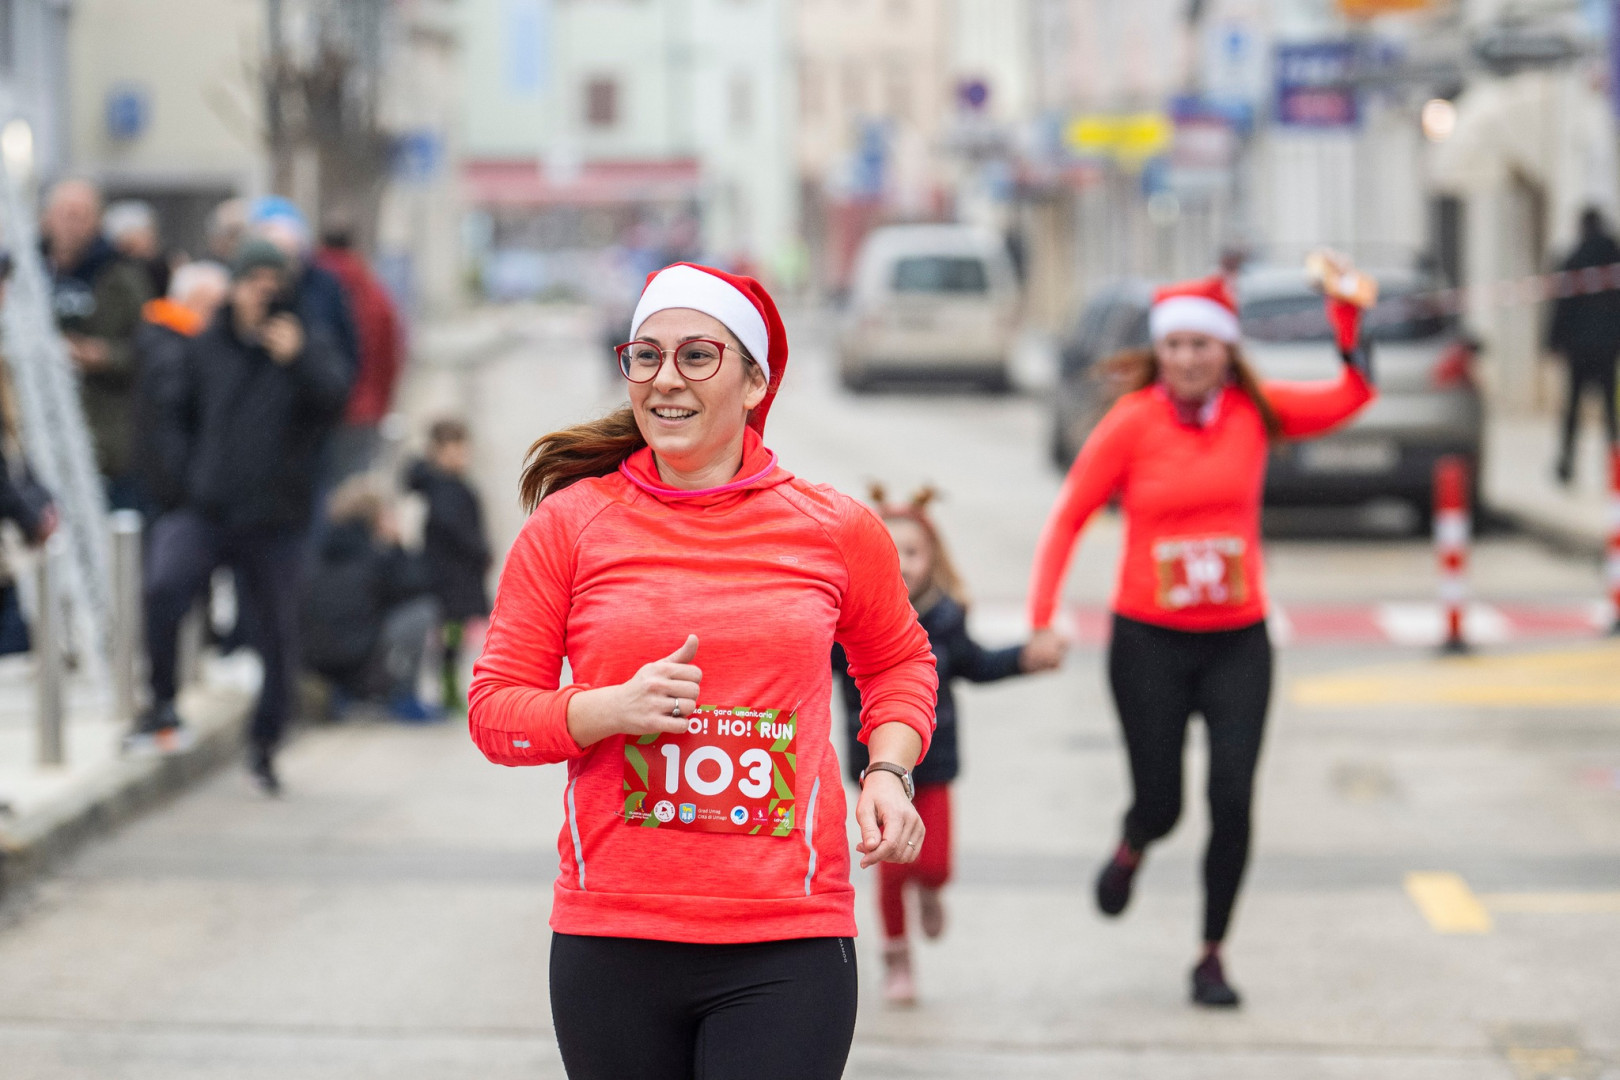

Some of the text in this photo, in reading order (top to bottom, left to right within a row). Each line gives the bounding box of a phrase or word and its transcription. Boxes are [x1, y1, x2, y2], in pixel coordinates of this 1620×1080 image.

[713, 709, 732, 717] gara
[735, 710, 773, 719] umanitaria
[687, 717, 793, 741] O! HO! RUN
[660, 743, 773, 799] 103
[838, 937, 848, 963] DOMYO
